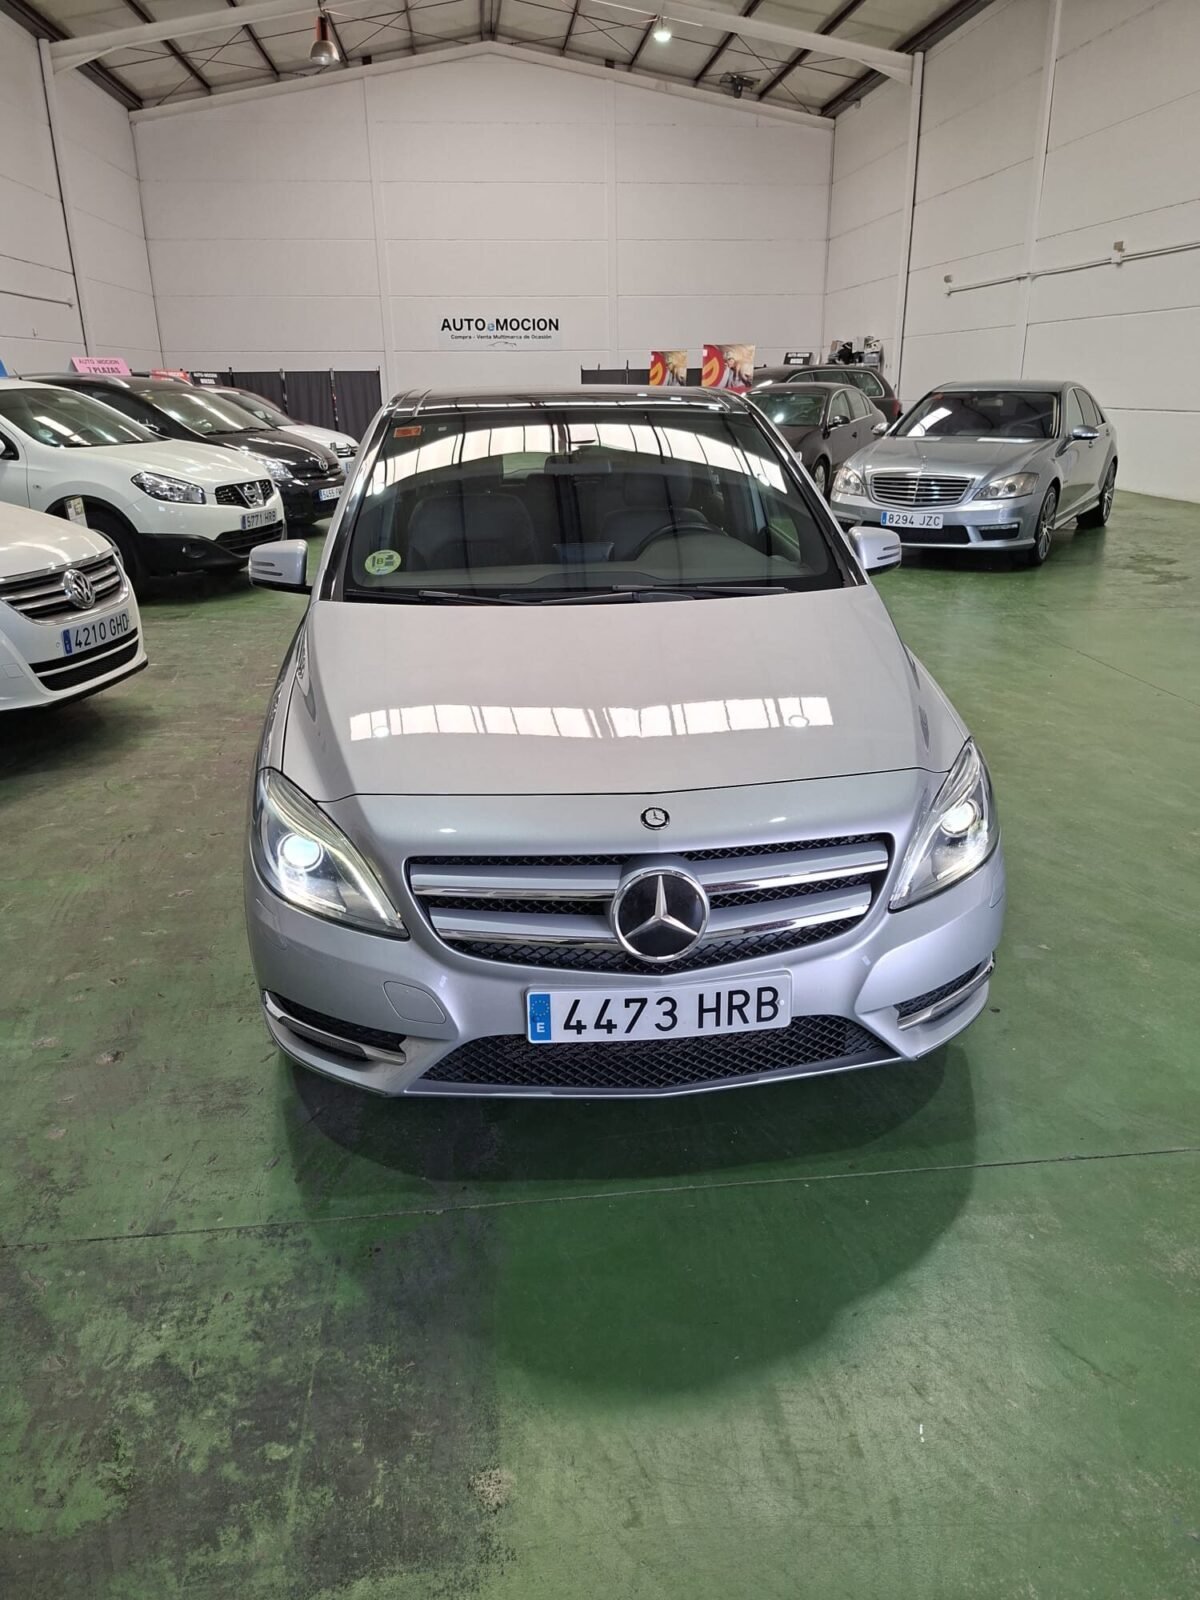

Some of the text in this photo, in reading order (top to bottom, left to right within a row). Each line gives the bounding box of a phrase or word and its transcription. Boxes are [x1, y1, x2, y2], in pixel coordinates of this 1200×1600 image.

[93, 366, 121, 375] PLAZAS
[246, 512, 263, 528] 5771
[888, 513, 940, 527] 8294 JZC
[75, 622, 107, 649] 4210
[109, 613, 129, 636] GHD
[536, 986, 779, 1035] E 4473 HRB
